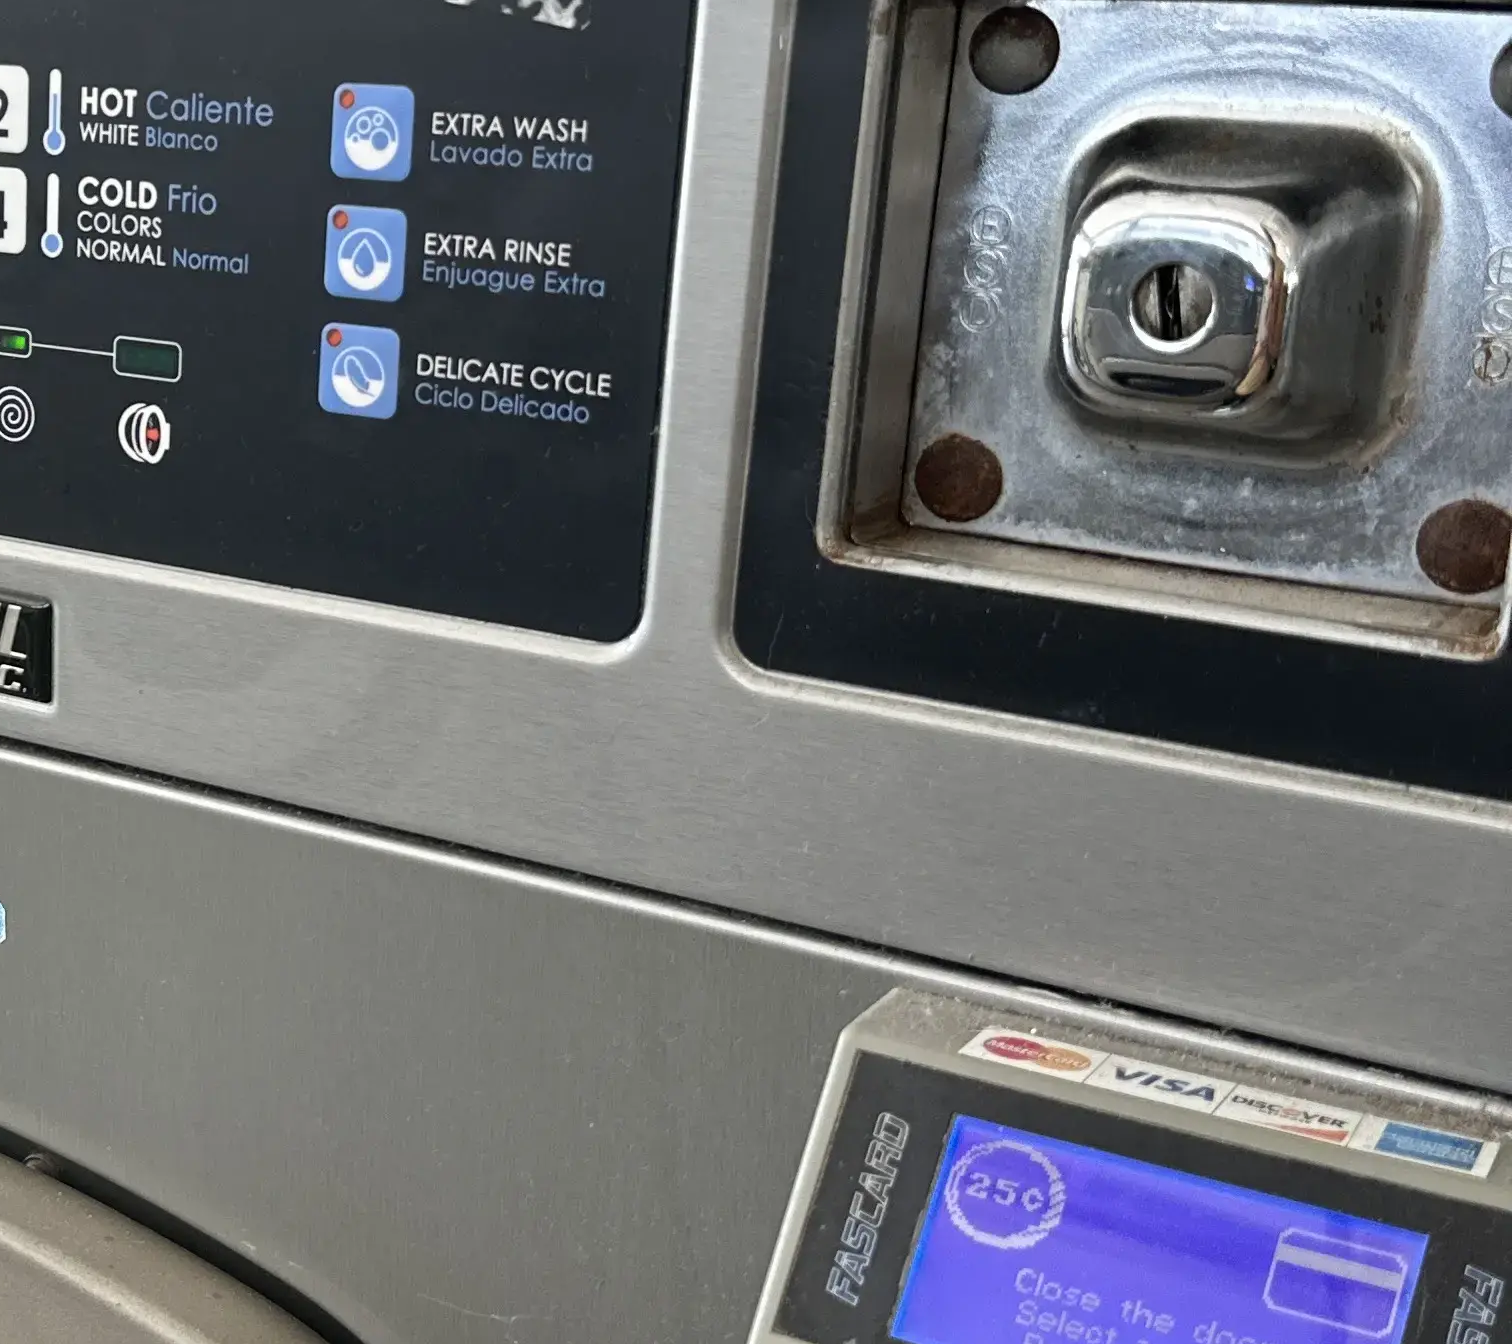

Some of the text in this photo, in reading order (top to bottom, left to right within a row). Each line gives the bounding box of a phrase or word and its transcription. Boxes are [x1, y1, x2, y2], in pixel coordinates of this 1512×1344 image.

[80, 86, 274, 127] HOT Caliente
[79, 123, 219, 152] WHITE Blanco
[431, 111, 587, 142] EXTRA WASH
[430, 140, 593, 172] Lavado Extra
[78, 177, 217, 216] COLD Frio
[77, 211, 163, 238] COLORS
[76, 238, 249, 275] NORMAL Normal
[424, 232, 572, 266] EXTRA RINSE
[422, 261, 606, 297] Enjuague Extra
[416, 355, 612, 397] DELICATE CYCLE
[414, 384, 589, 424] Ciclo Delicado
[1113, 1064, 1216, 1104] VISA
[1231, 1094, 1349, 1131] DISCOVER
[964, 1169, 1047, 1211] 25¢
[824, 1111, 912, 1308] FASCARD
[1014, 1267, 1103, 1312] Close
[1121, 1298, 1177, 1337] the
